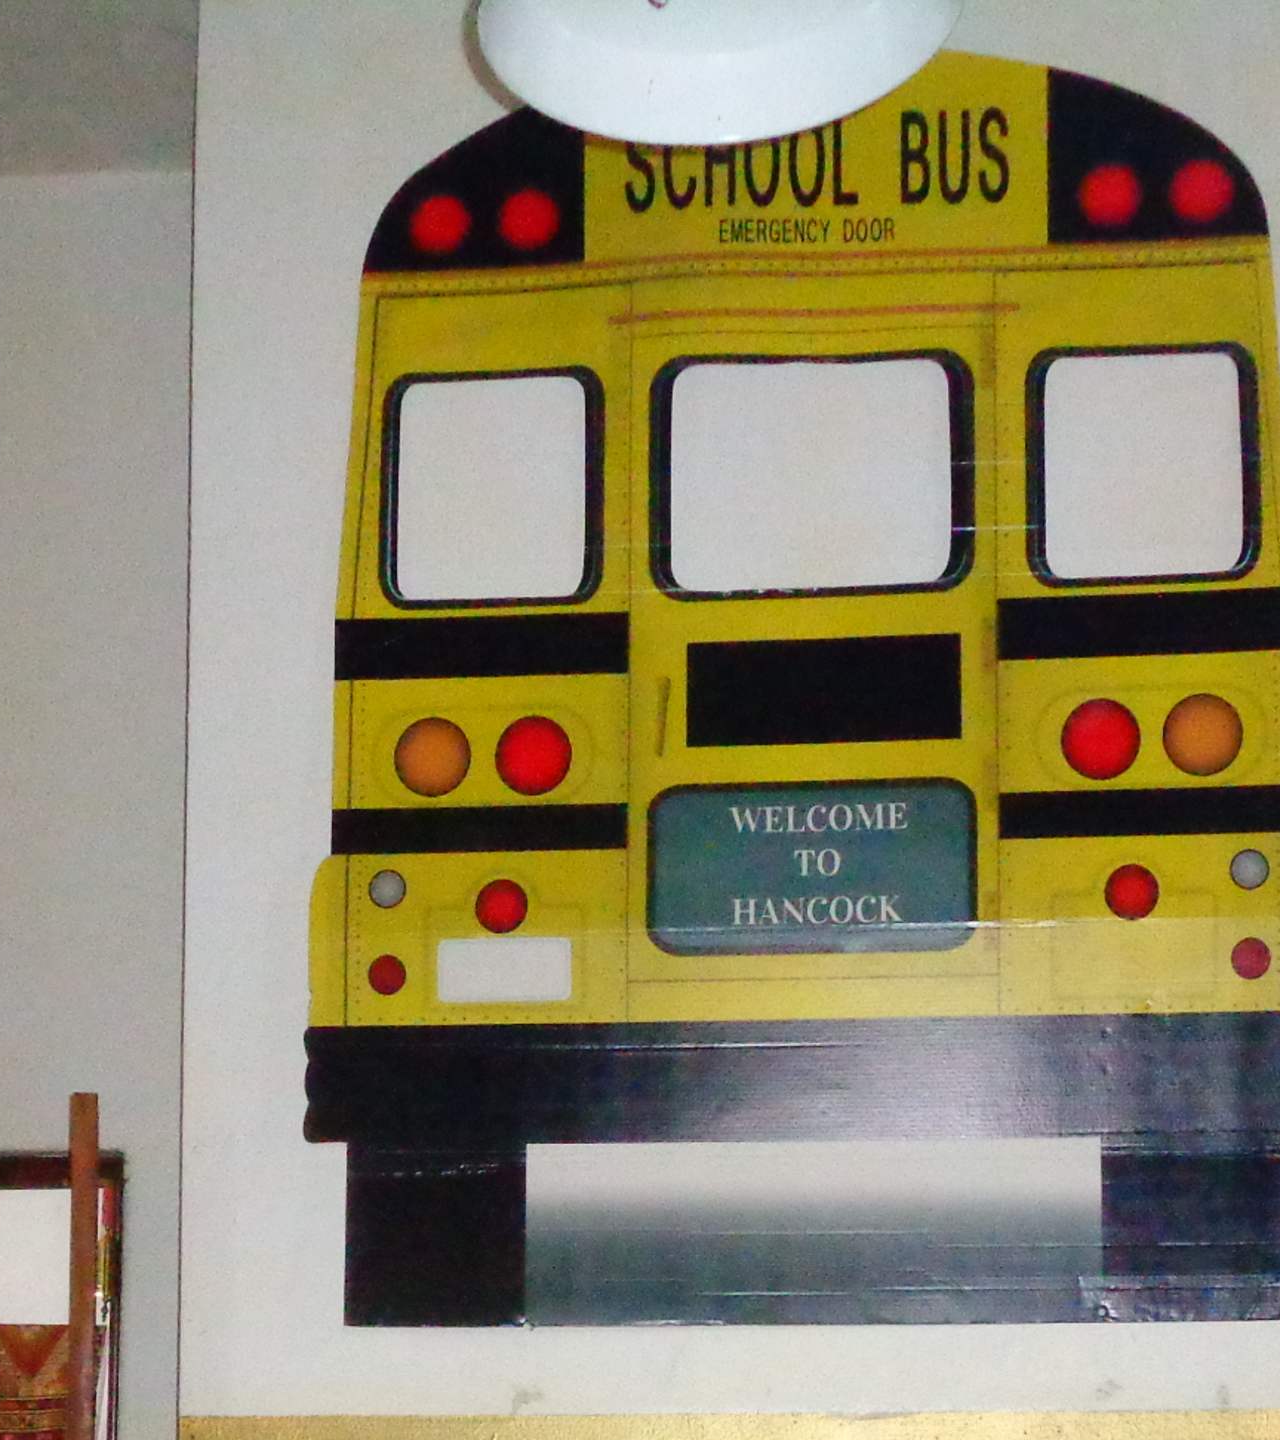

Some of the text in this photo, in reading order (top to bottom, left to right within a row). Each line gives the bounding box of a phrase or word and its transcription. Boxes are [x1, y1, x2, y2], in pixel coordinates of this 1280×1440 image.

[625, 106, 1009, 214] SCHOOL BUS
[719, 217, 895, 243] EMERGENCY DOOR
[729, 802, 908, 833] WELCOME
[793, 848, 842, 877] TO
[732, 895, 902, 925] HANCOCK
